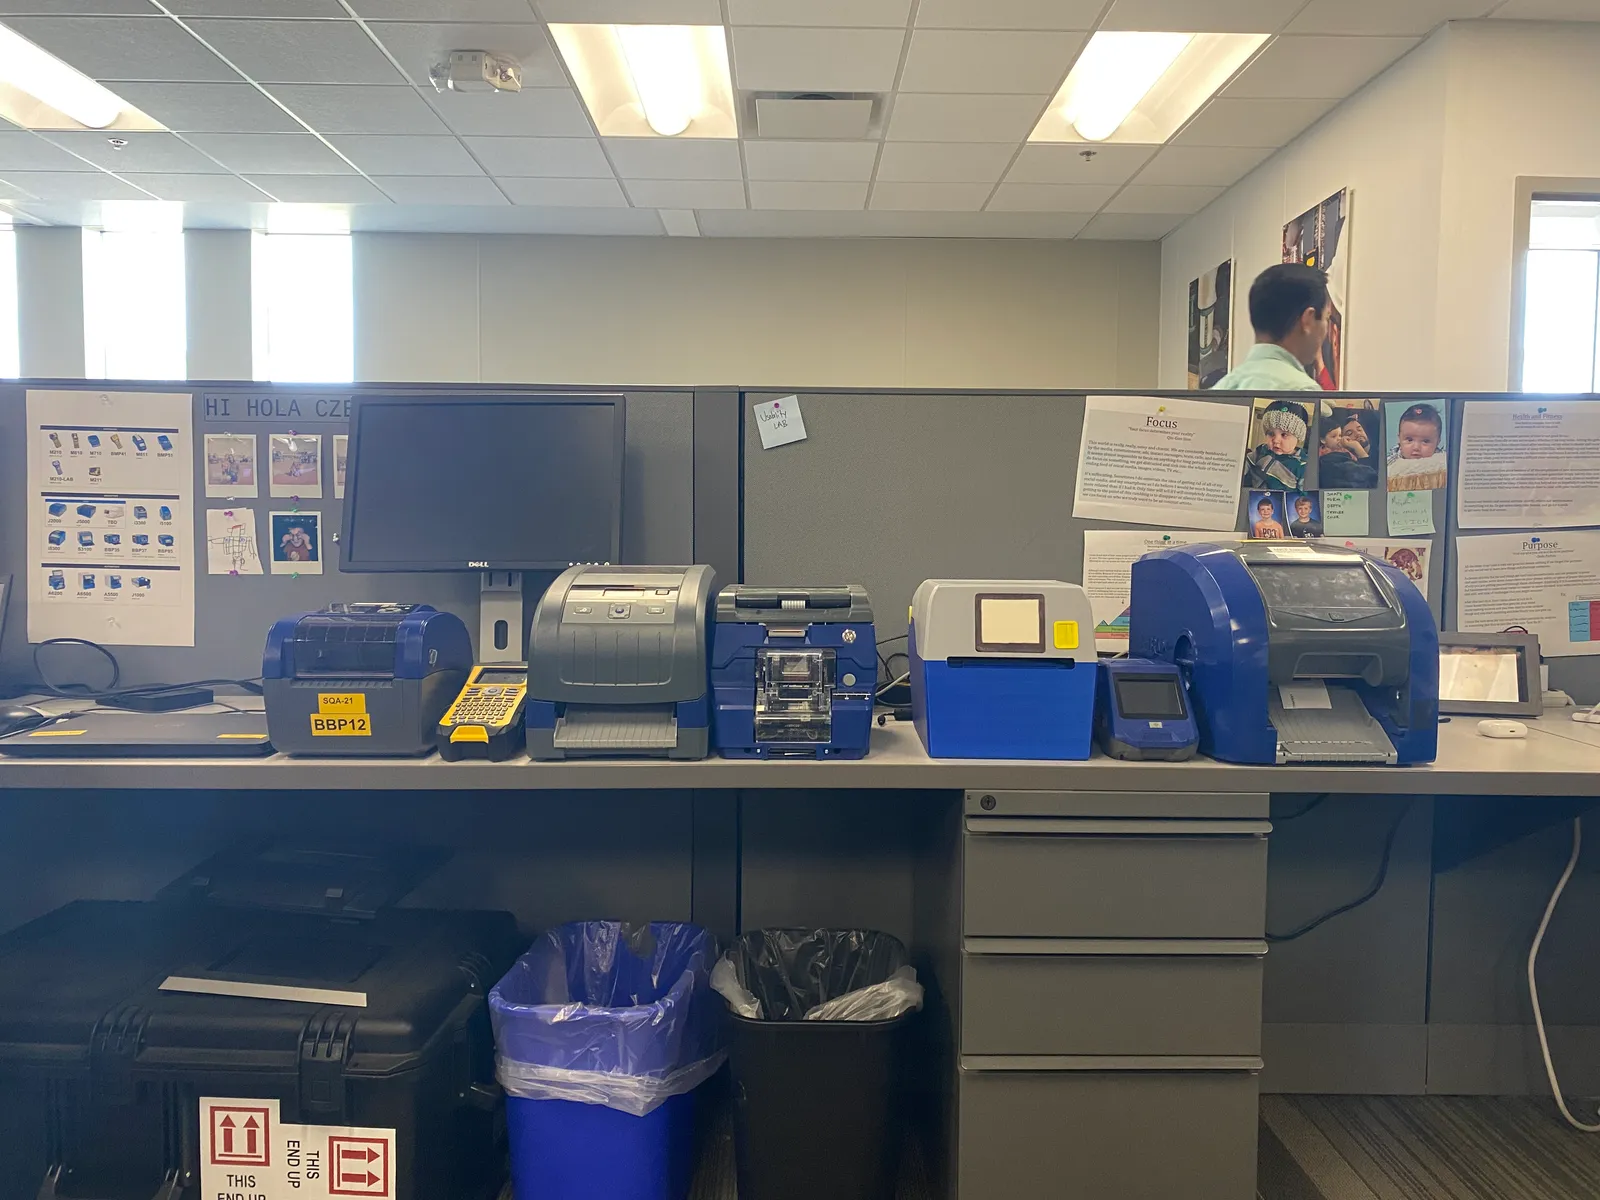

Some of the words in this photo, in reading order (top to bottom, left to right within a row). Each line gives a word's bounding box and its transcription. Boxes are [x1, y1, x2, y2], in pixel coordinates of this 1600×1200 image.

[206, 398, 230, 416] HI
[247, 398, 301, 416] HOLA
[1146, 416, 1178, 429] Focus
[1522, 542, 1558, 550] Purpose
[314, 718, 367, 731] BBP12
[287, 1140, 300, 1167] END
[306, 1150, 320, 1180] THIS
[226, 1174, 256, 1188] THIS
[287, 1170, 300, 1188] UP
